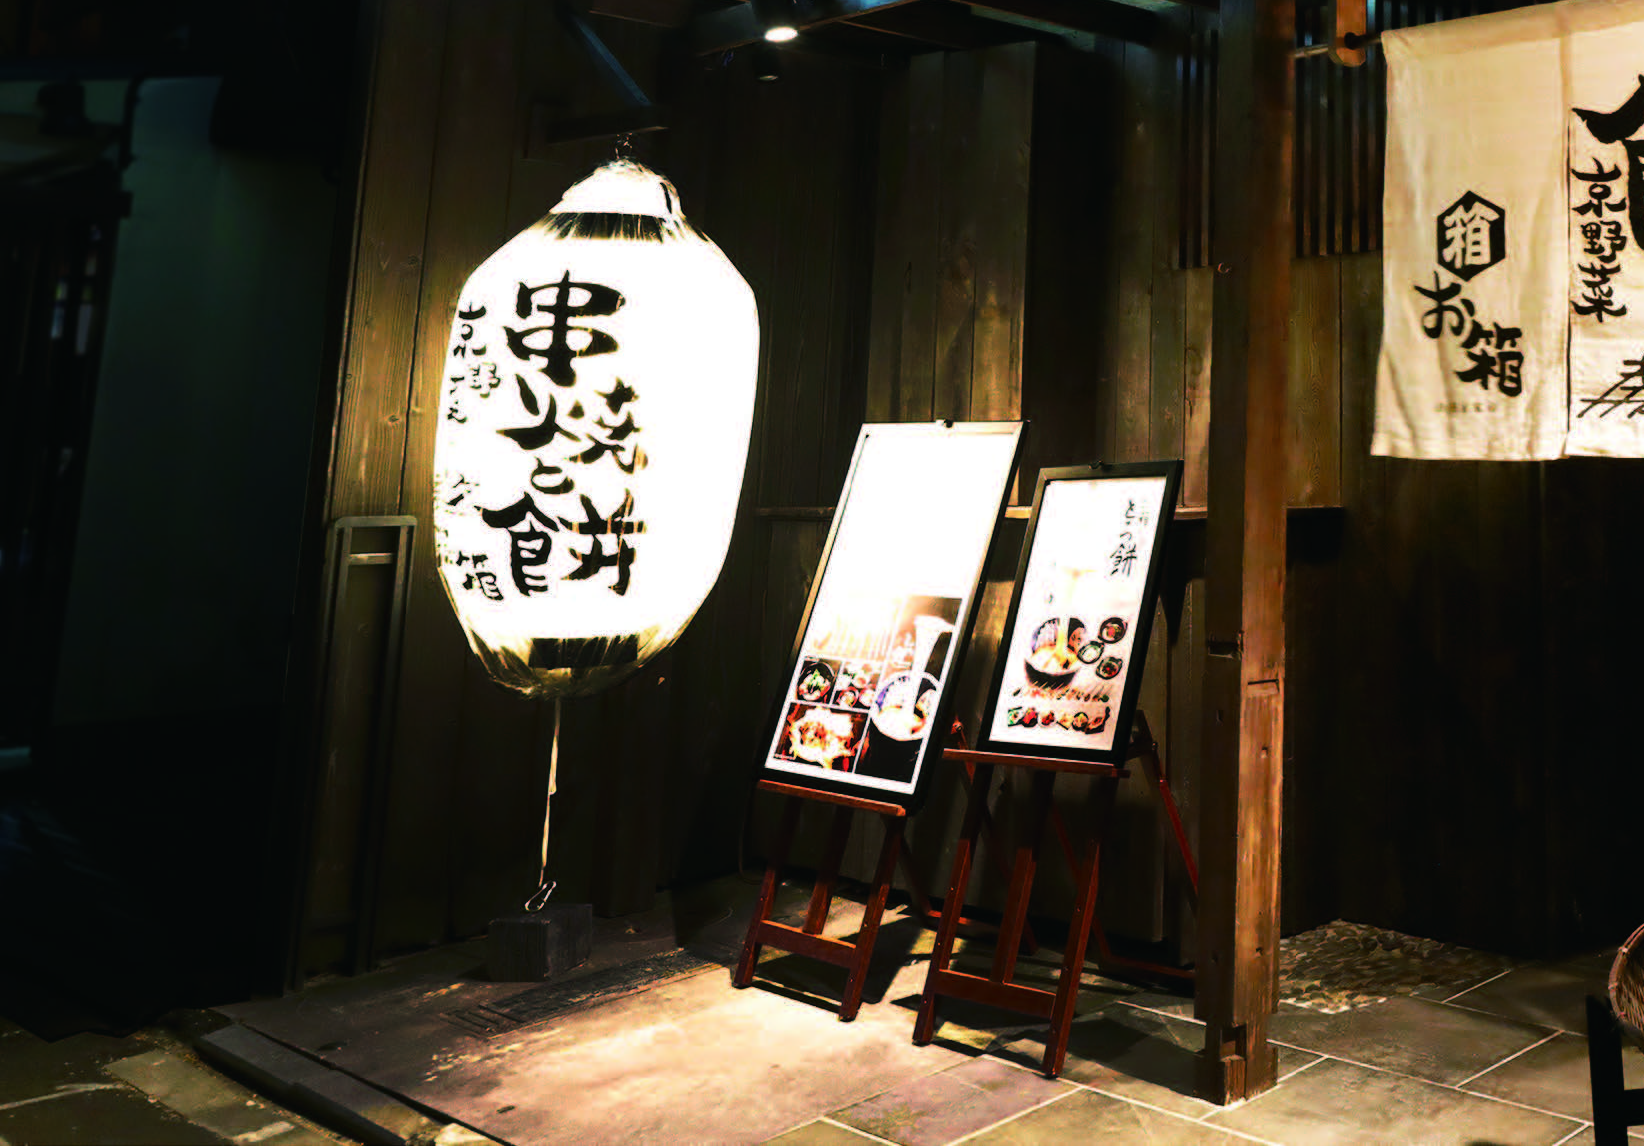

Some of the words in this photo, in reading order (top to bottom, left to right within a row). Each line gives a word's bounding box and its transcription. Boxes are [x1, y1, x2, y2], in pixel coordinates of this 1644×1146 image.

[1442, 201, 1501, 270] 箱
[1571, 157, 1628, 323] 京野菜
[1413, 271, 1524, 398] お箱
